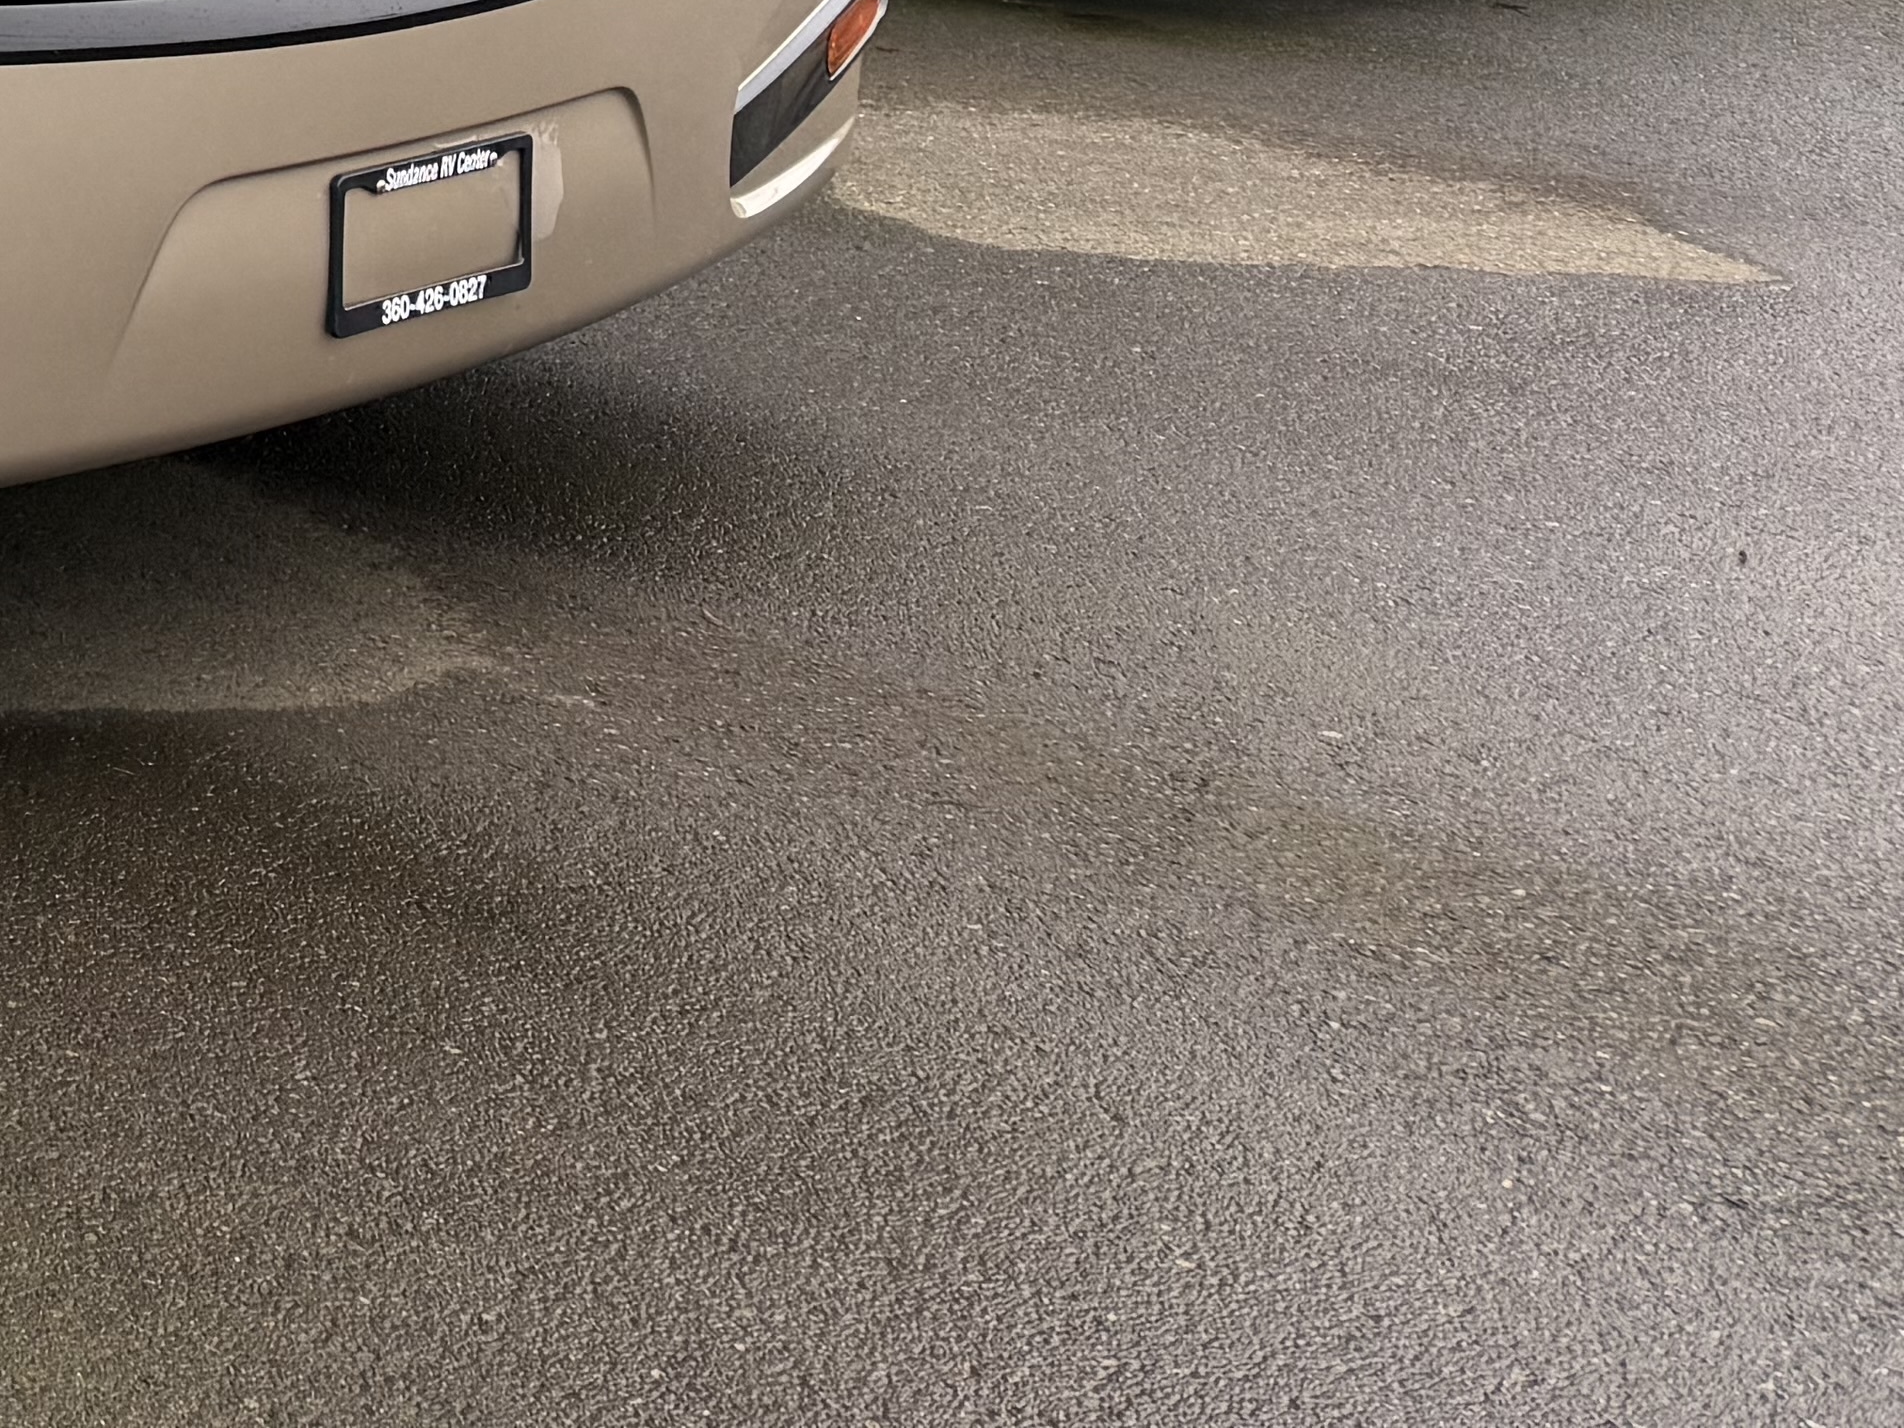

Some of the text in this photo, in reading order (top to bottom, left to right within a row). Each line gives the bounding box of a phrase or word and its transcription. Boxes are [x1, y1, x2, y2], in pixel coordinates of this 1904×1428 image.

[385, 147, 491, 192] Sundance RV Center
[381, 274, 488, 326] 360-426-0827
